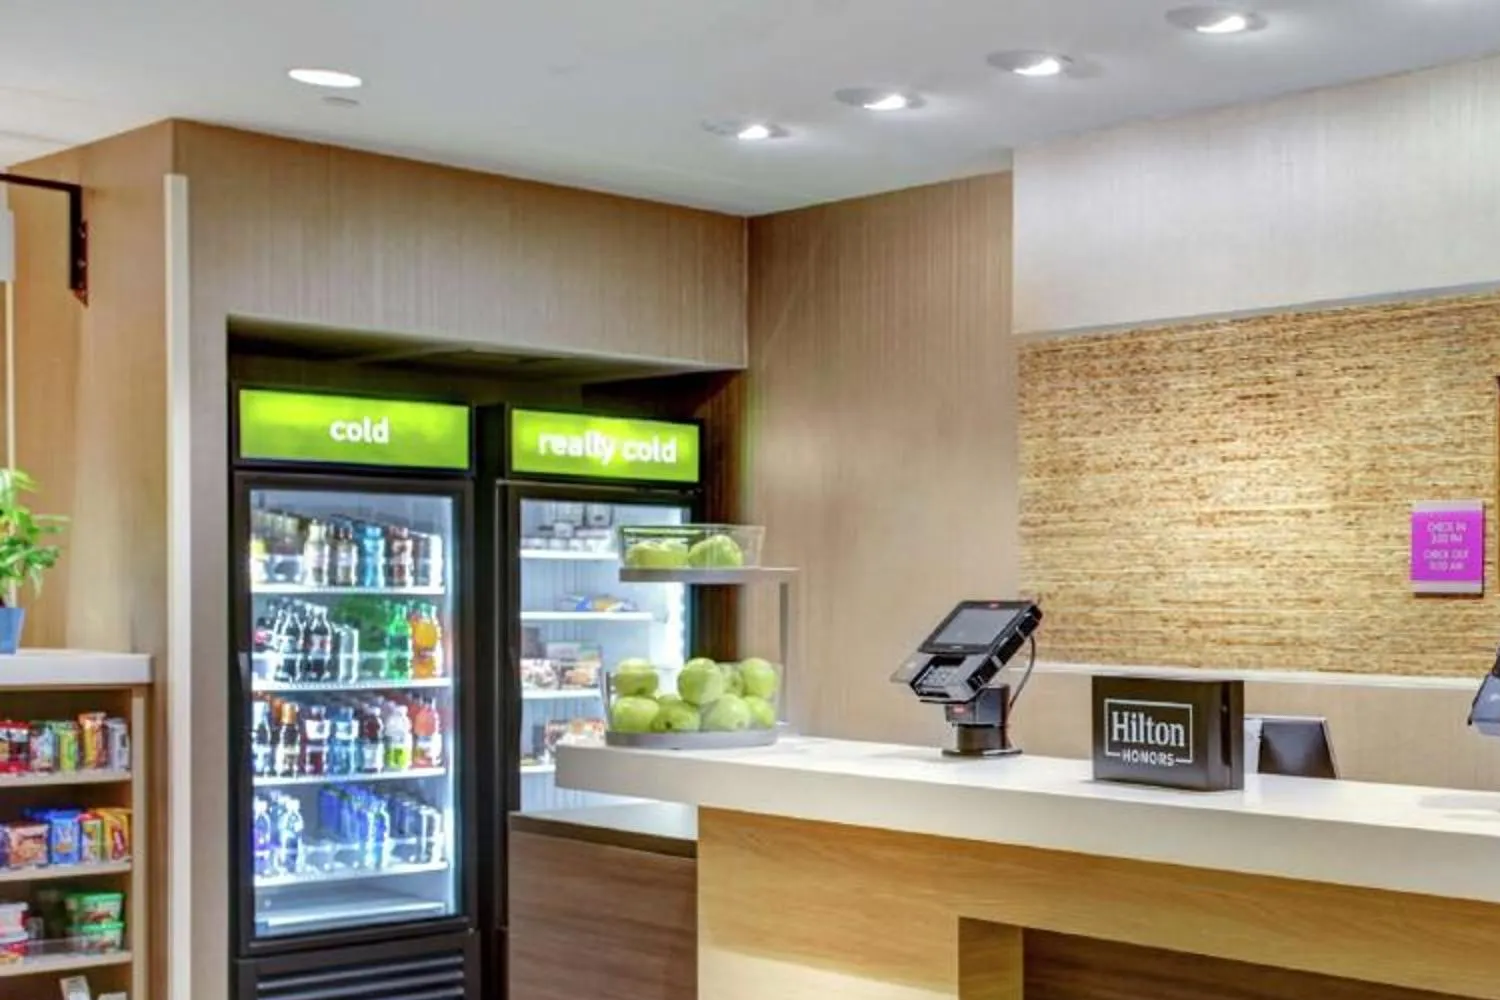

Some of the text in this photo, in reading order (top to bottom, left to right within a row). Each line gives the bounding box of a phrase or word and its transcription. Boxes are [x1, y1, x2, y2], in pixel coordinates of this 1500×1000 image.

[329, 416, 391, 446] cold
[537, 430, 678, 465] really cold
[1111, 711, 1186, 747] Hilton
[1122, 750, 1176, 767] HONORS
